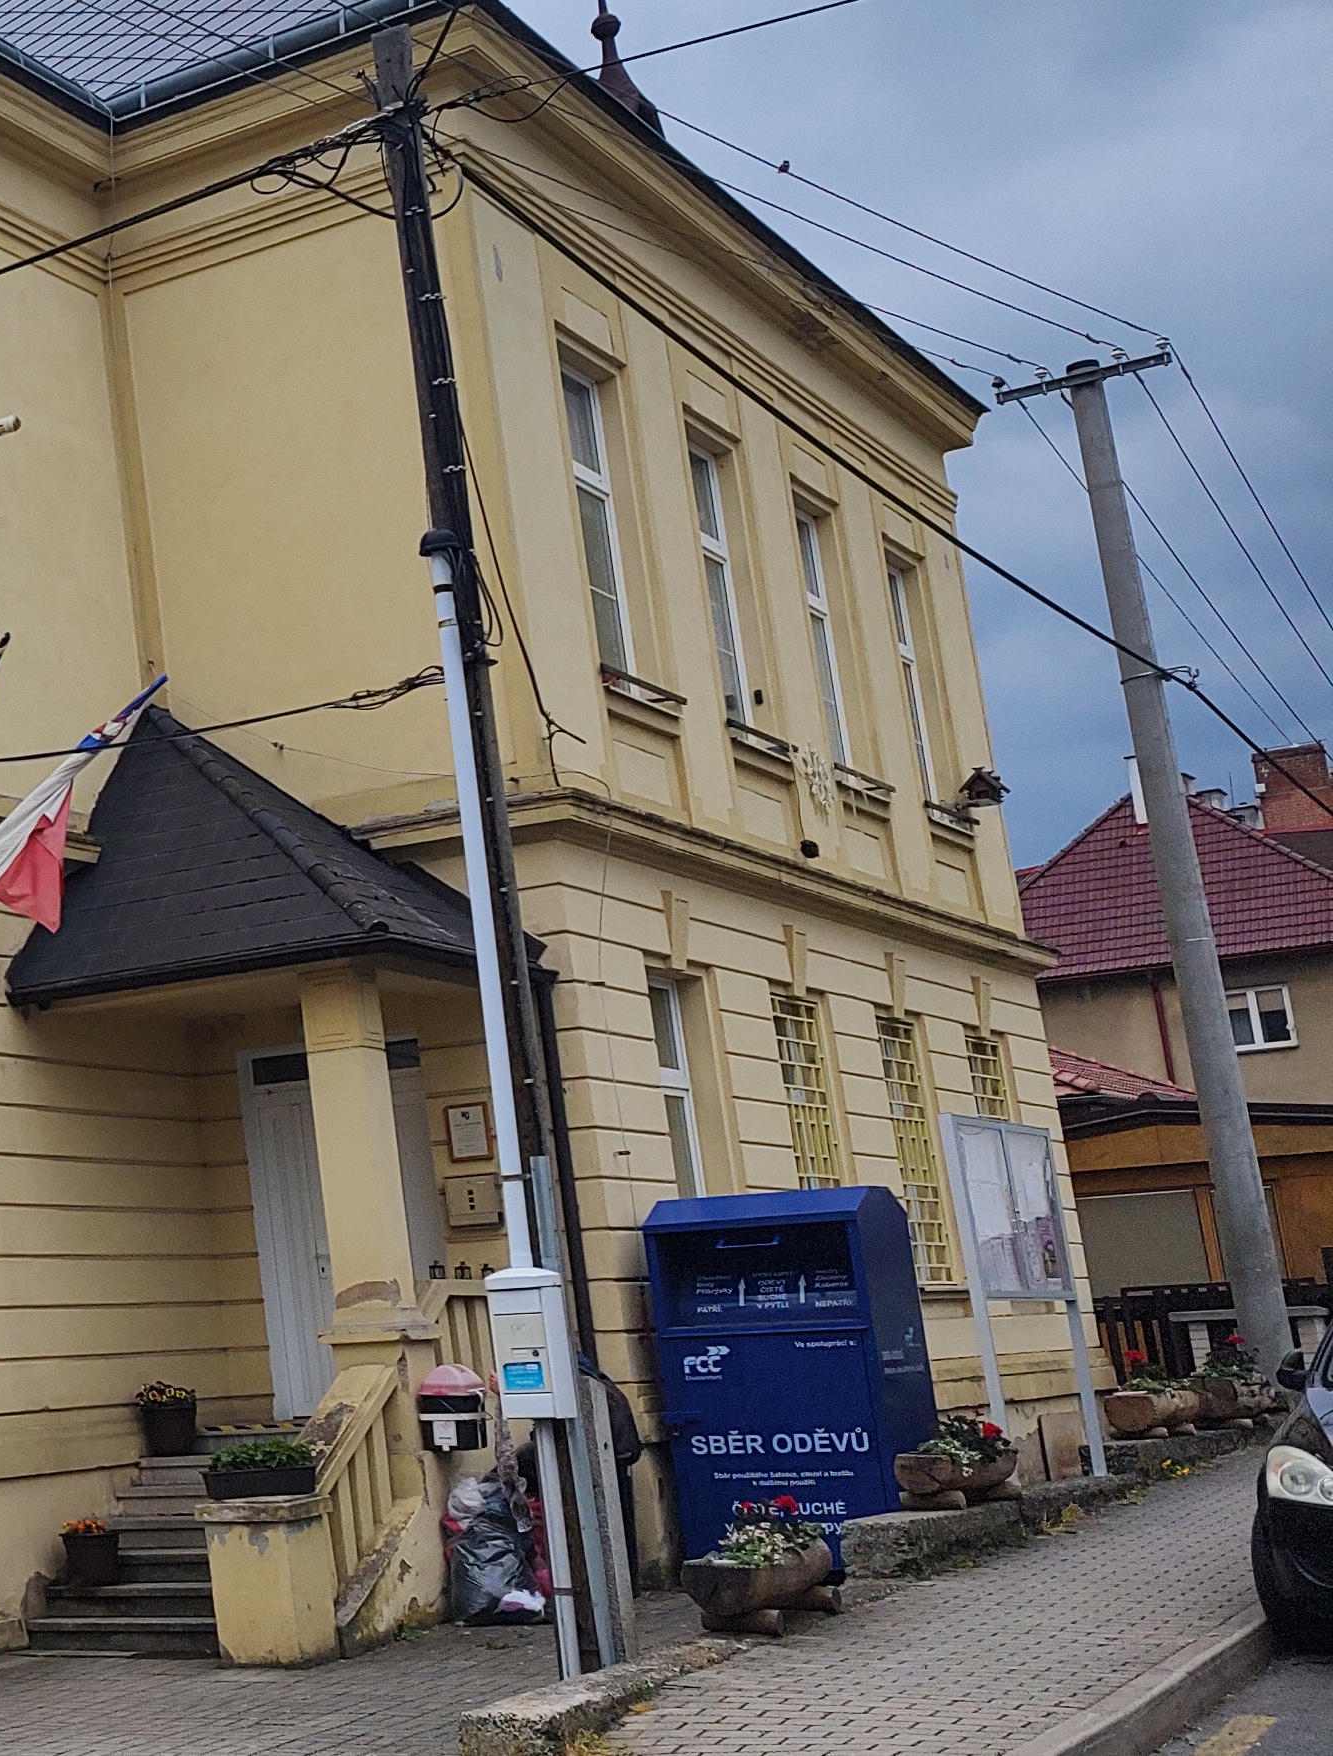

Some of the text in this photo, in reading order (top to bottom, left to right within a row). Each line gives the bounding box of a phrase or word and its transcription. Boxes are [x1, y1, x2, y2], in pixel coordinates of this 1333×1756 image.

[683, 1355, 722, 1374] FCC
[691, 1426, 870, 1455] SBĚR ODĚVŮ
[789, 1499, 847, 1516] UCHÉ
